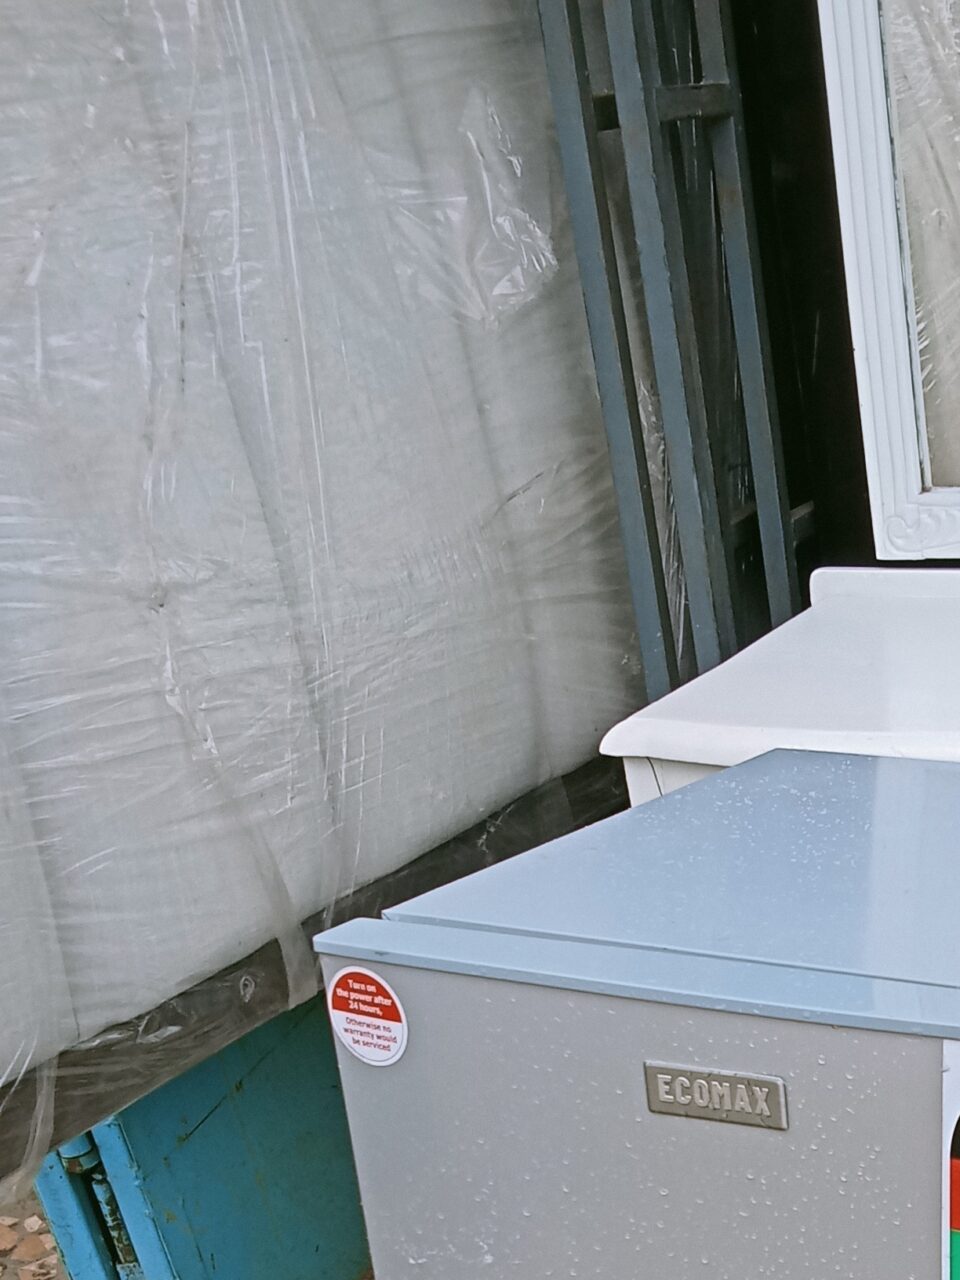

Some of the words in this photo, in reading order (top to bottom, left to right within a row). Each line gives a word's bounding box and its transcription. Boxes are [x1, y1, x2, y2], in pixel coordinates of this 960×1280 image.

[347, 979, 366, 991] Turn
[366, 984, 377, 993] on
[336, 987, 349, 999] the
[350, 991, 373, 1003] power
[374, 995, 393, 1007] after
[348, 1000, 359, 1010] 24
[346, 1017, 381, 1030] Otherwise
[383, 1025, 392, 1033] no
[343, 1027, 375, 1040] warranty
[376, 1034, 398, 1044] would
[352, 1037, 361, 1045] be
[362, 1040, 391, 1052] serviced
[657, 1073, 771, 1117] ECOMAX
